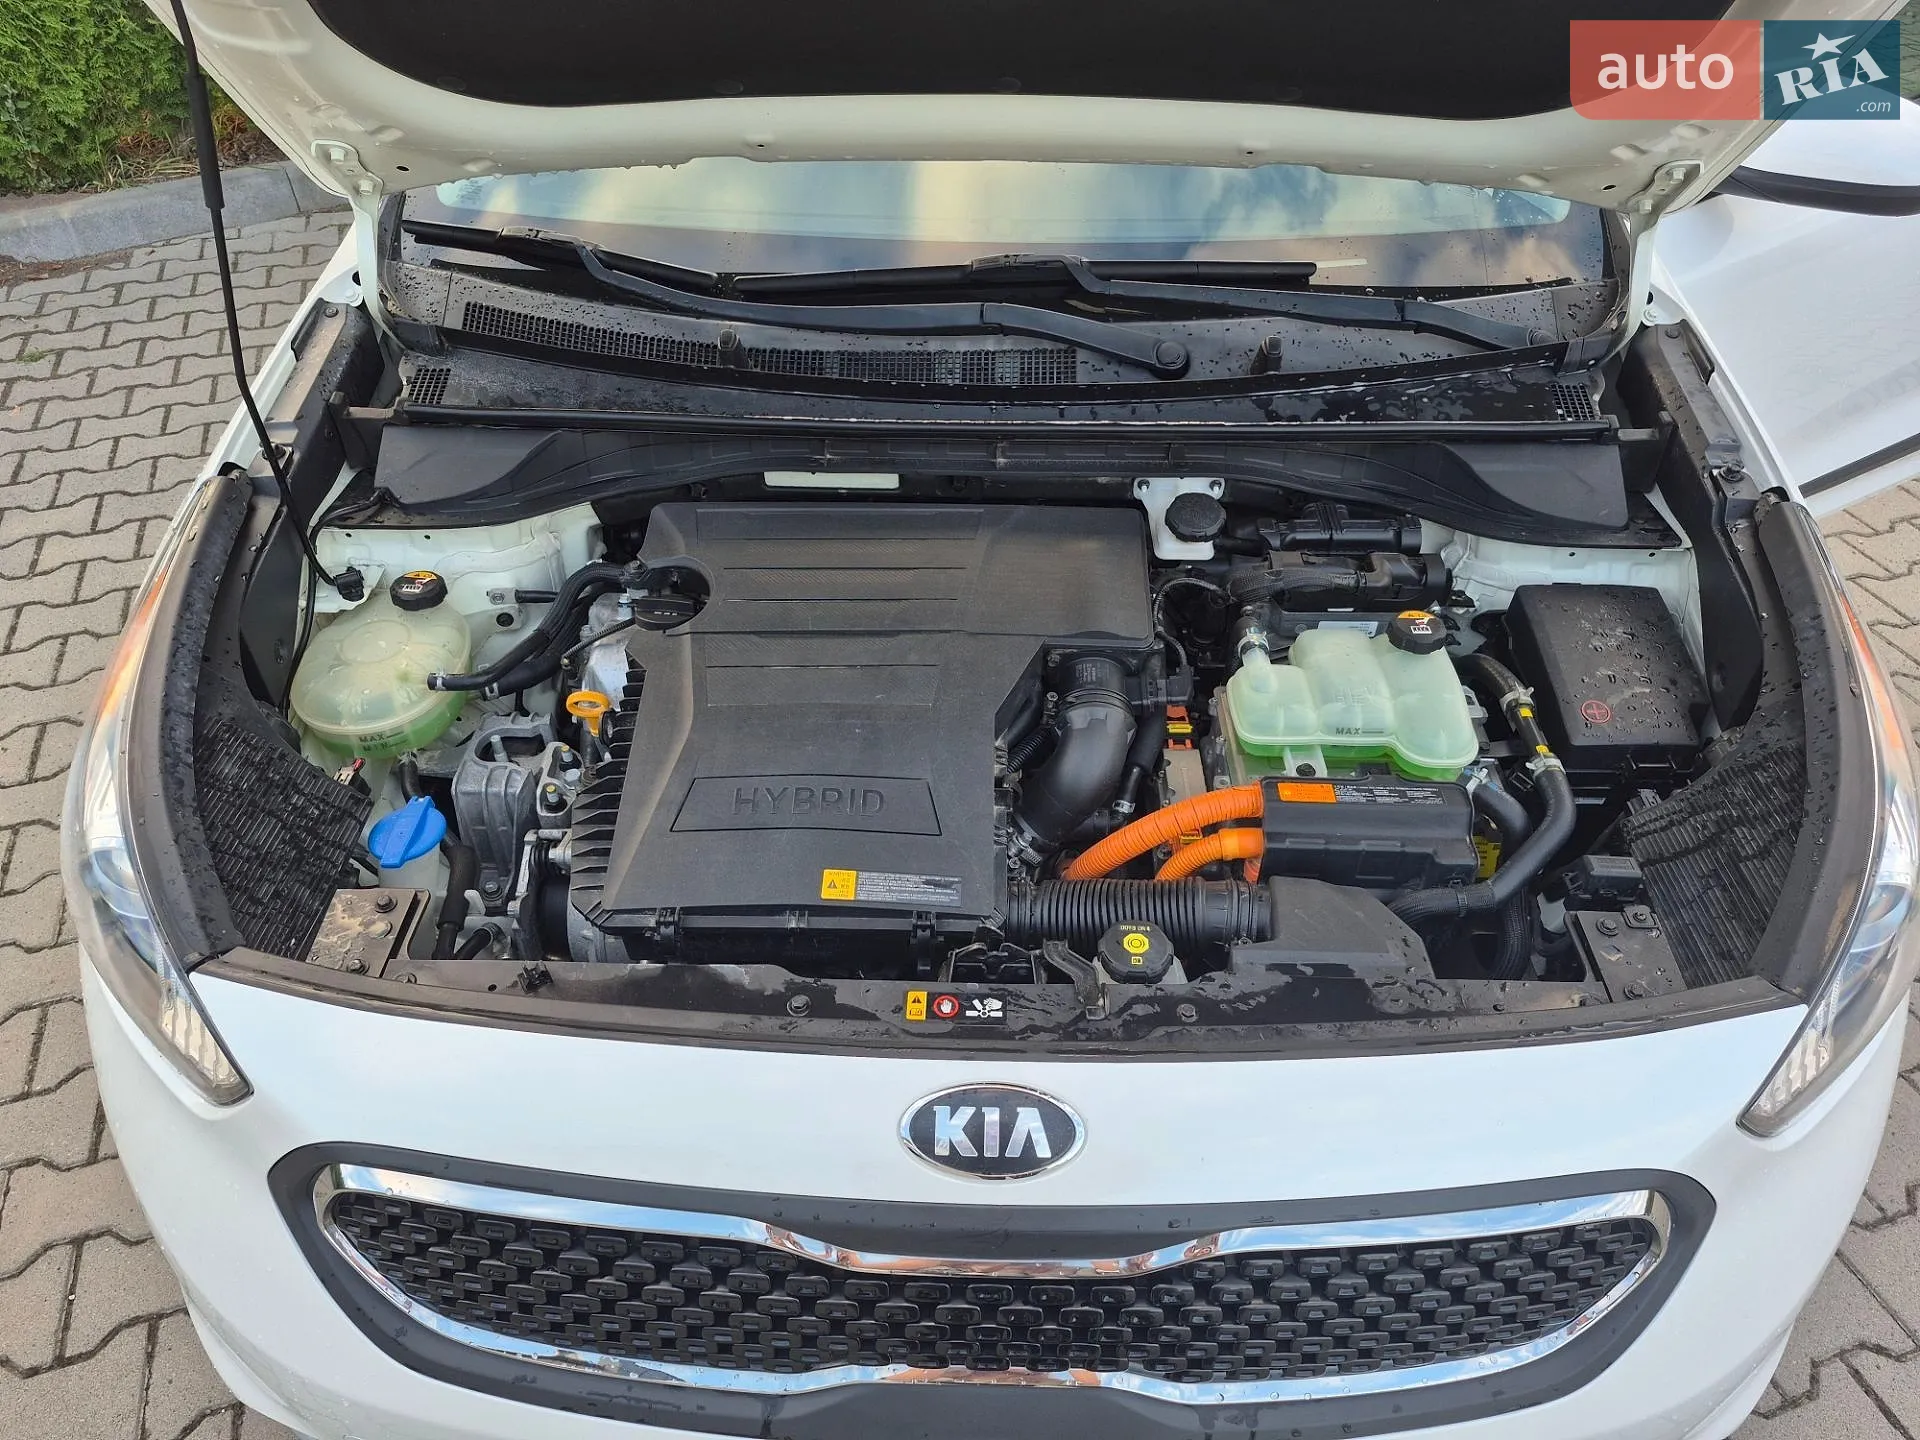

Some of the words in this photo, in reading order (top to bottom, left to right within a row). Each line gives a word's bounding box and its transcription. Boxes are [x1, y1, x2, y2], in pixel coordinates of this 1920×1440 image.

[359, 733, 384, 742] MAX
[1335, 727, 1361, 736] MAX
[732, 786, 885, 817] HYBRID
[933, 1105, 1052, 1158] KIA
